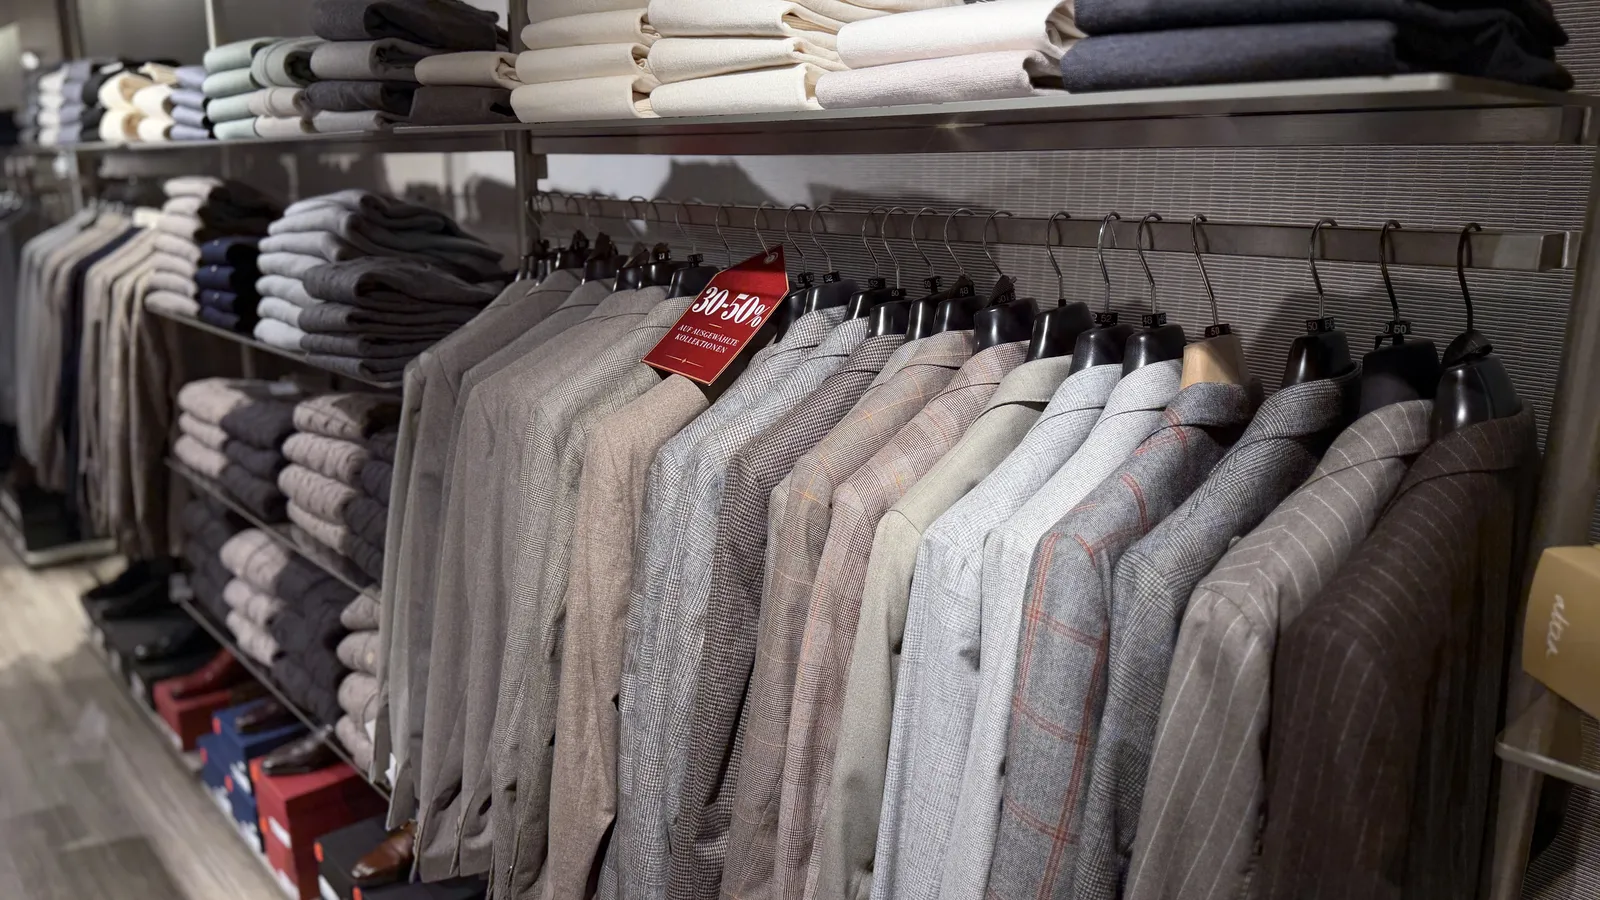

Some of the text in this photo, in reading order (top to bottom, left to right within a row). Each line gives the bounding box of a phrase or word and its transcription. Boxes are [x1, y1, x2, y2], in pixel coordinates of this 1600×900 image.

[691, 286, 771, 328] 30-50%
[1101, 314, 1112, 323] 52
[1143, 315, 1153, 325] 48
[1210, 326, 1220, 335] 50
[1308, 321, 1318, 331] 50
[1393, 324, 1407, 334] 50
[678, 324, 740, 347] AUF AUSGEWÄHLTE
[674, 333, 728, 354] KOLLEKTIONEN
